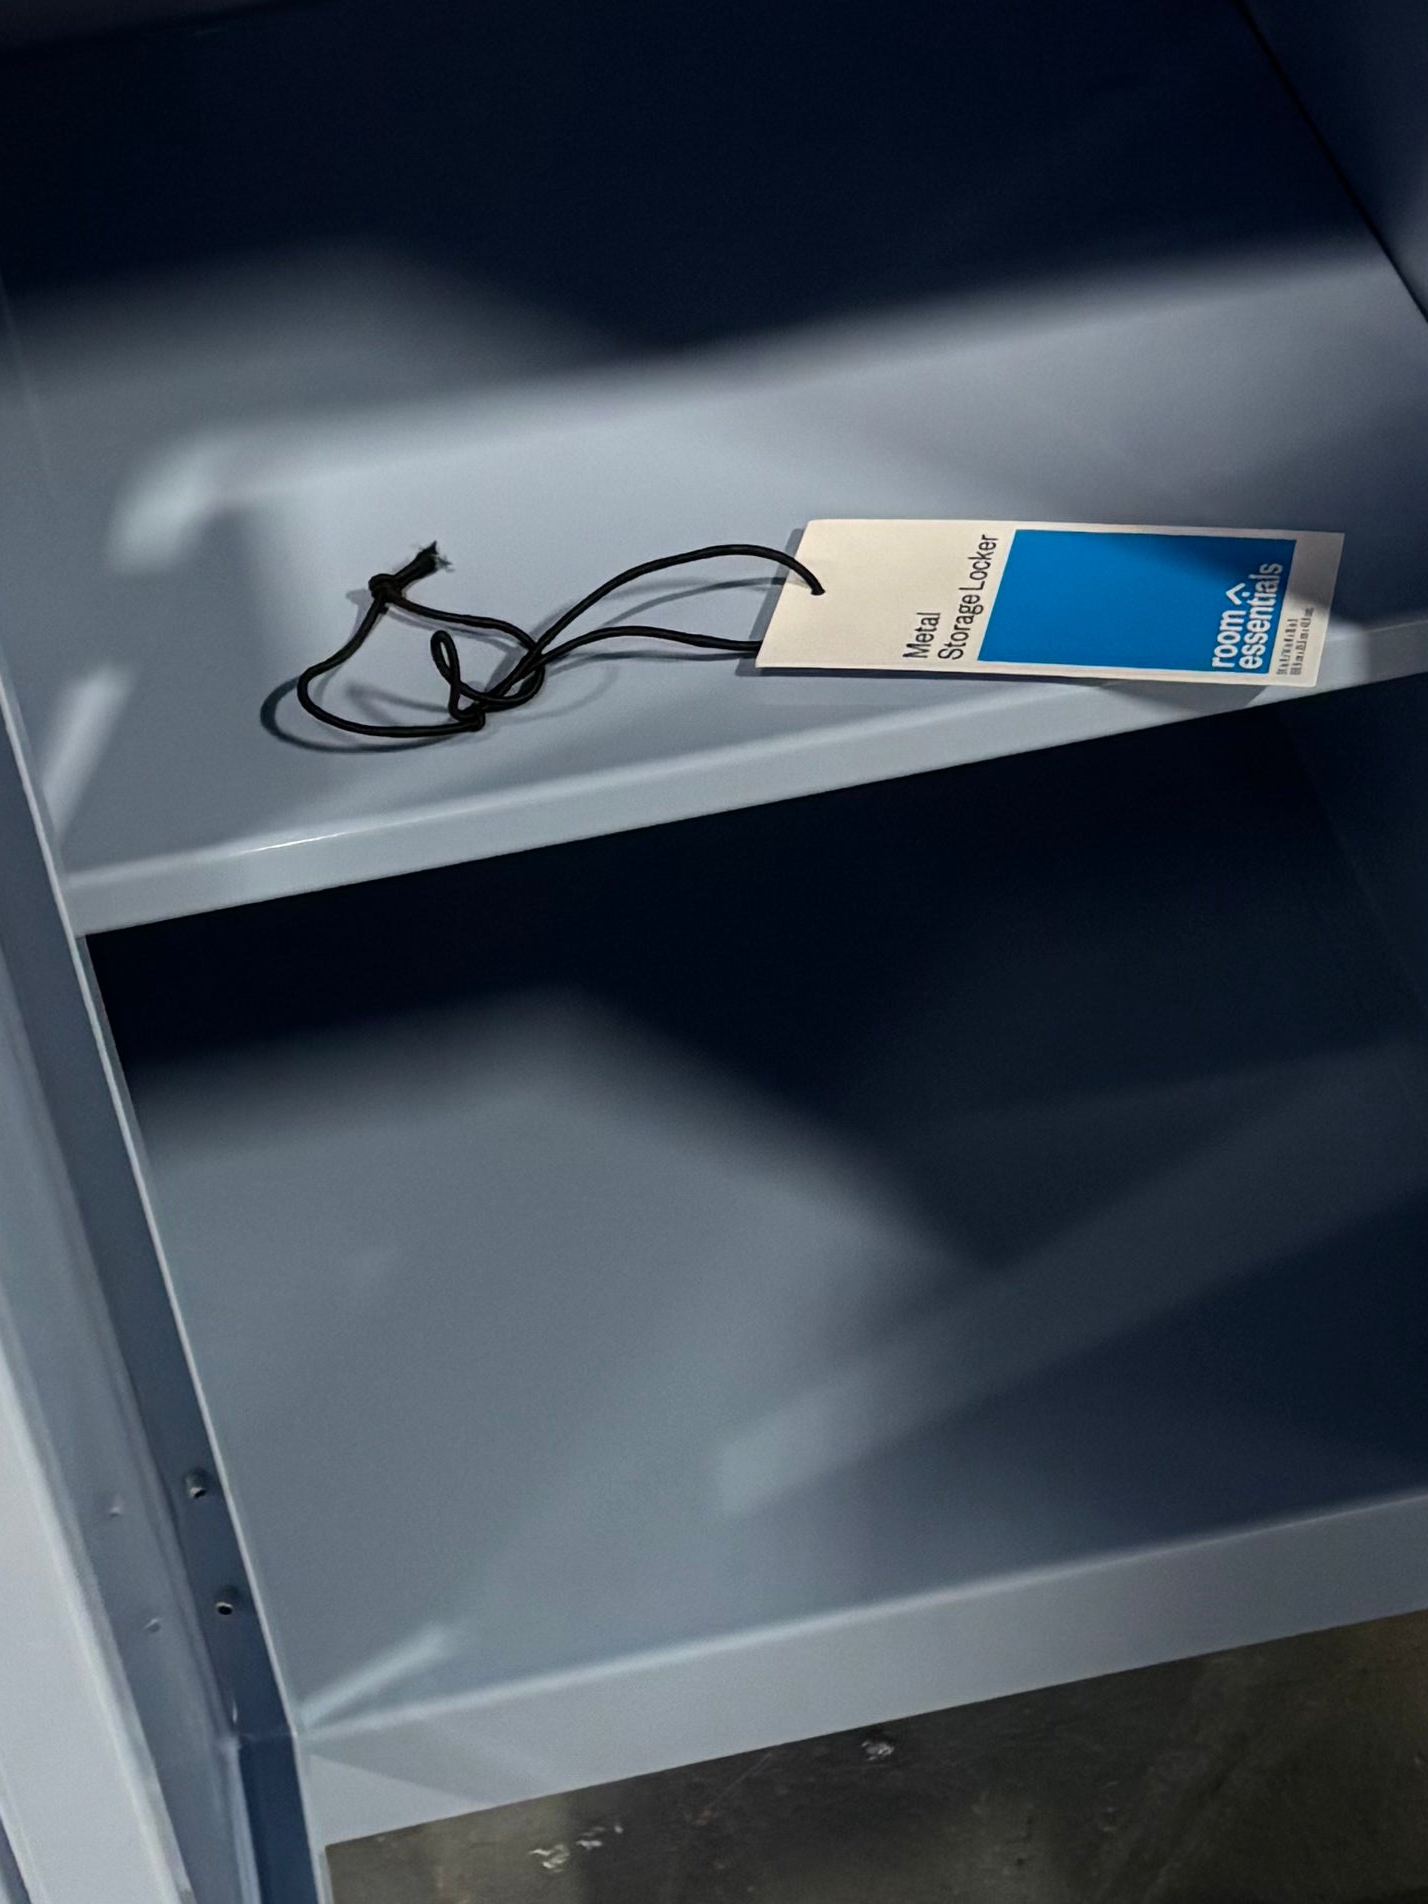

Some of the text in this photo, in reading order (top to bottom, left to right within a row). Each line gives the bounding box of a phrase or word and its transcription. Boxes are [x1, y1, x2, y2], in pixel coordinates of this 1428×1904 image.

[903, 611, 942, 660] Metal
[939, 534, 1000, 660] Storage Locker
[1210, 608, 1246, 671] room
[1238, 561, 1284, 671] essentials
